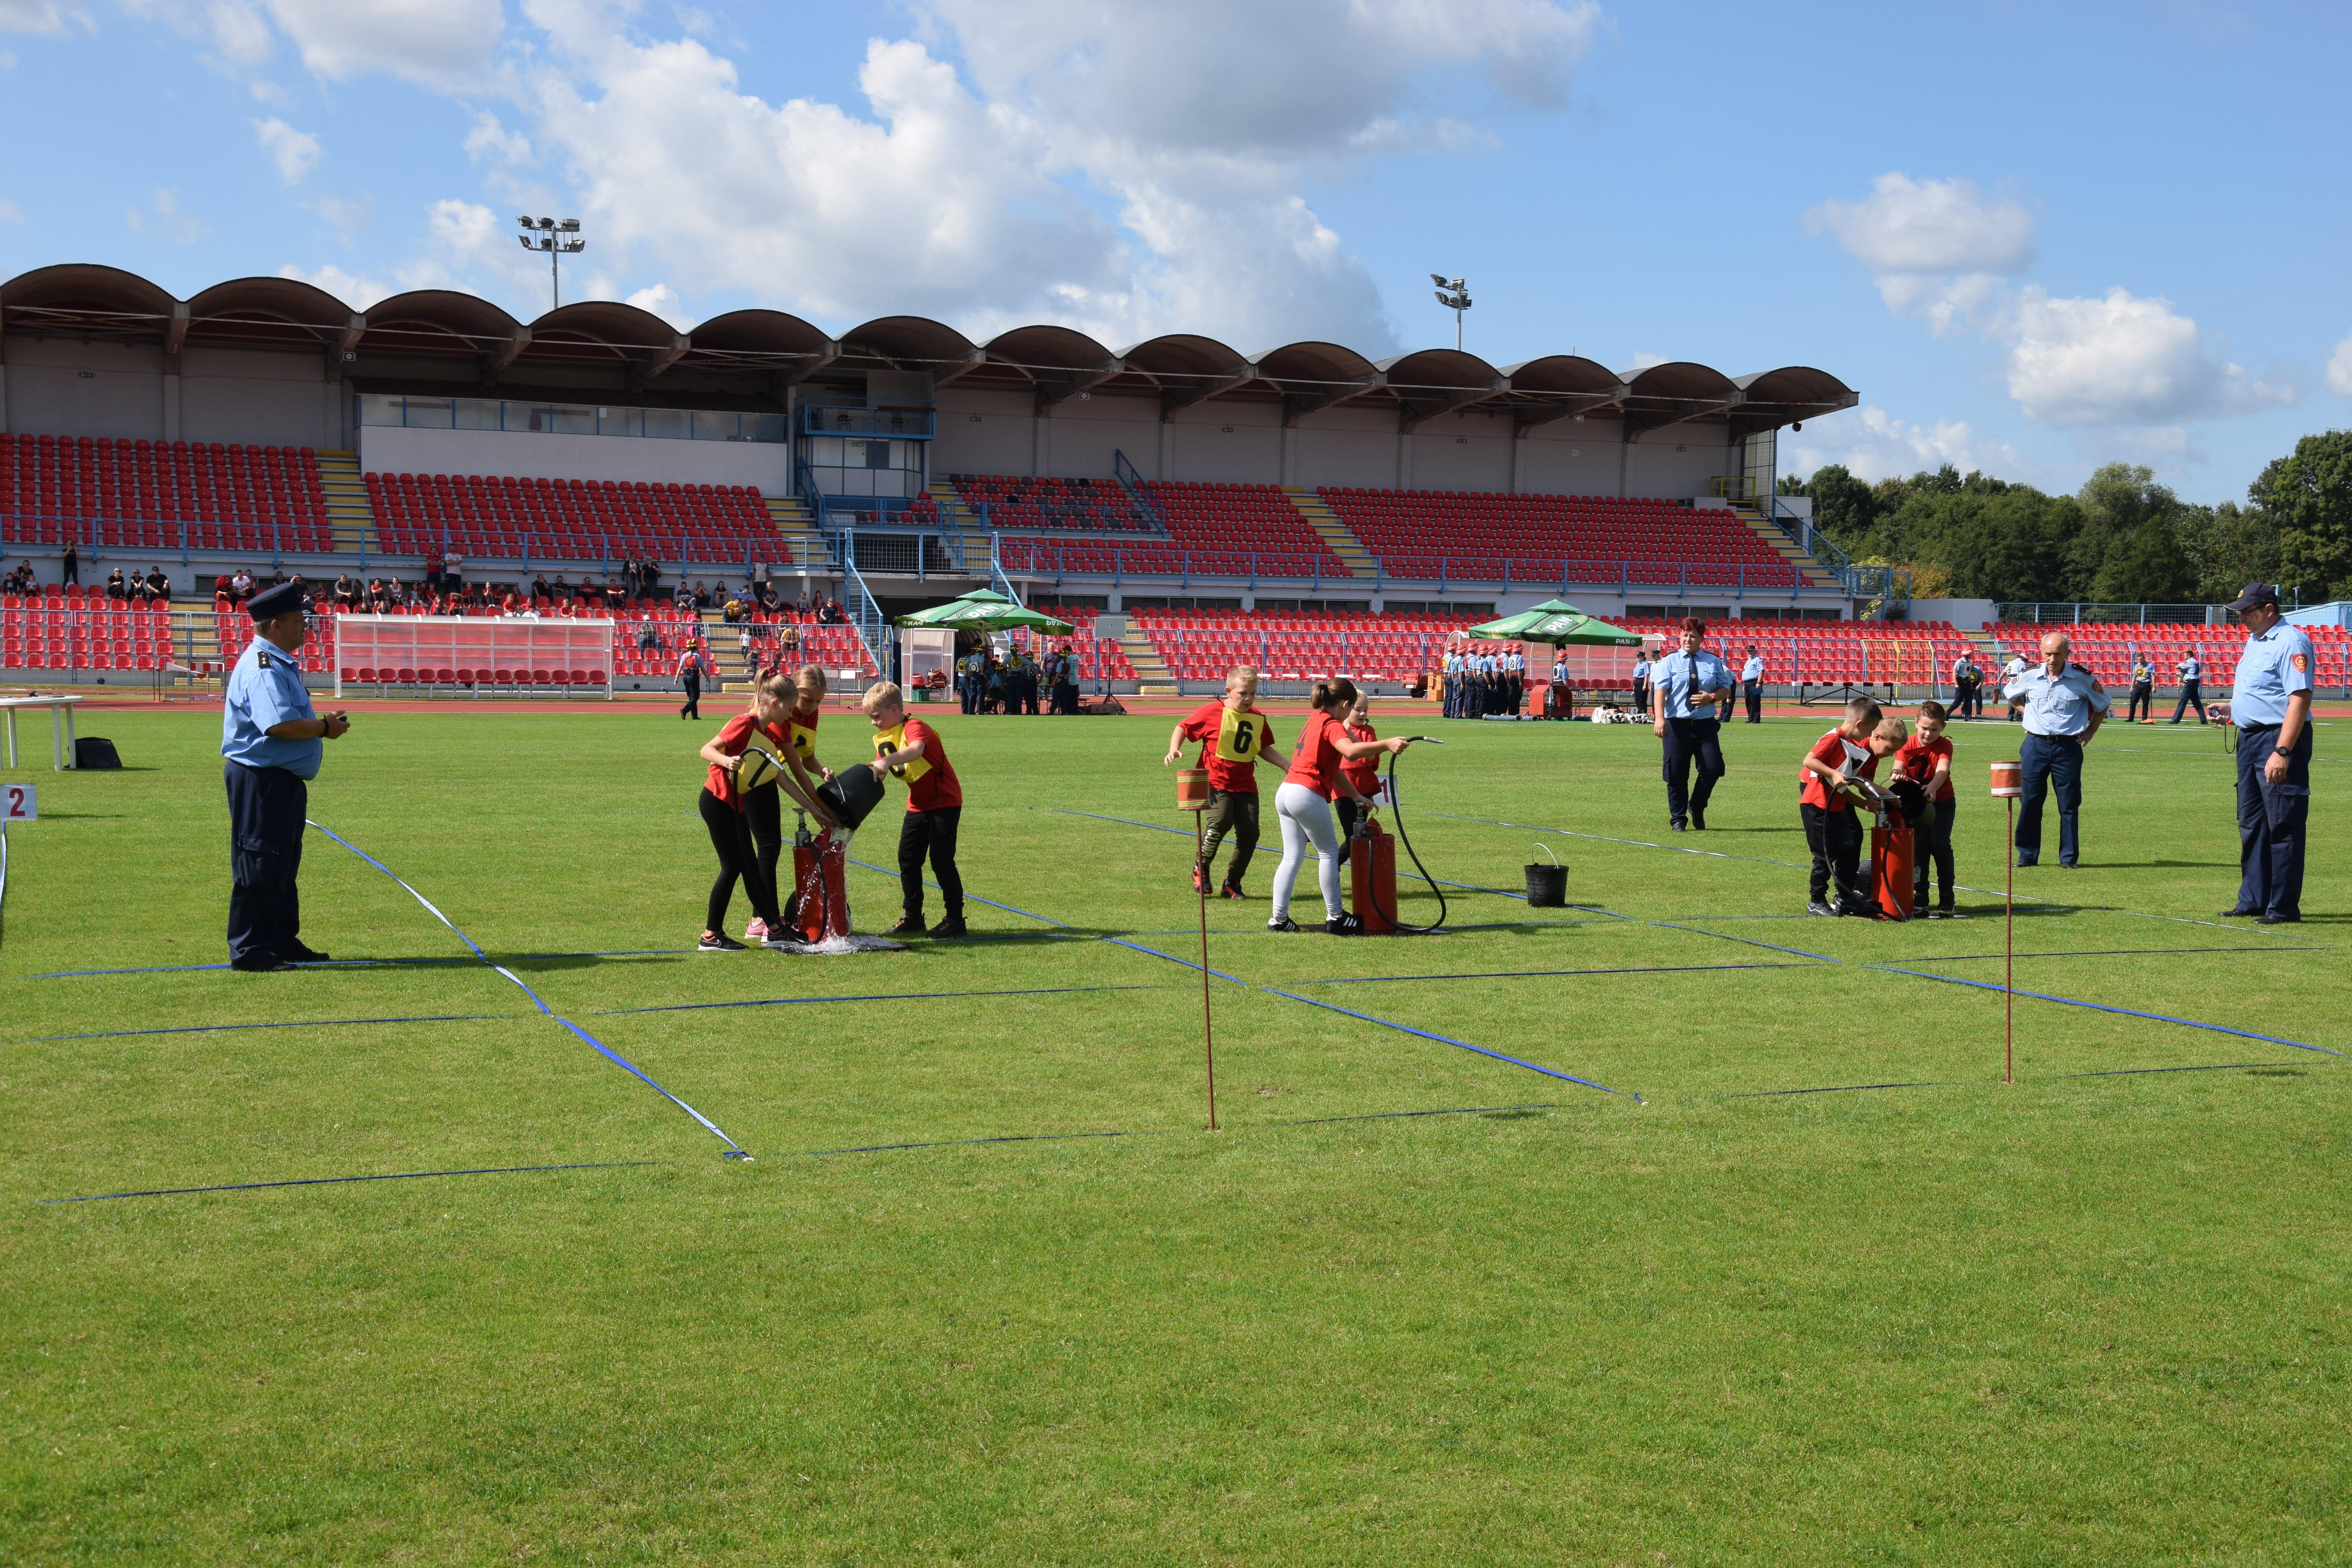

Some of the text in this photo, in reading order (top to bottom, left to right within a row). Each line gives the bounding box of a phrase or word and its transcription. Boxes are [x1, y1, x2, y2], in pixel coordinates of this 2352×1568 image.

[966, 604, 1000, 618] PAN
[1544, 616, 1573, 631] PAN
[2109, 710, 2113, 718] 3
[1234, 720, 1253, 754] 6
[1295, 722, 1310, 756] 4
[9, 788, 25, 817] 2
[1379, 779, 1389, 803] 1
